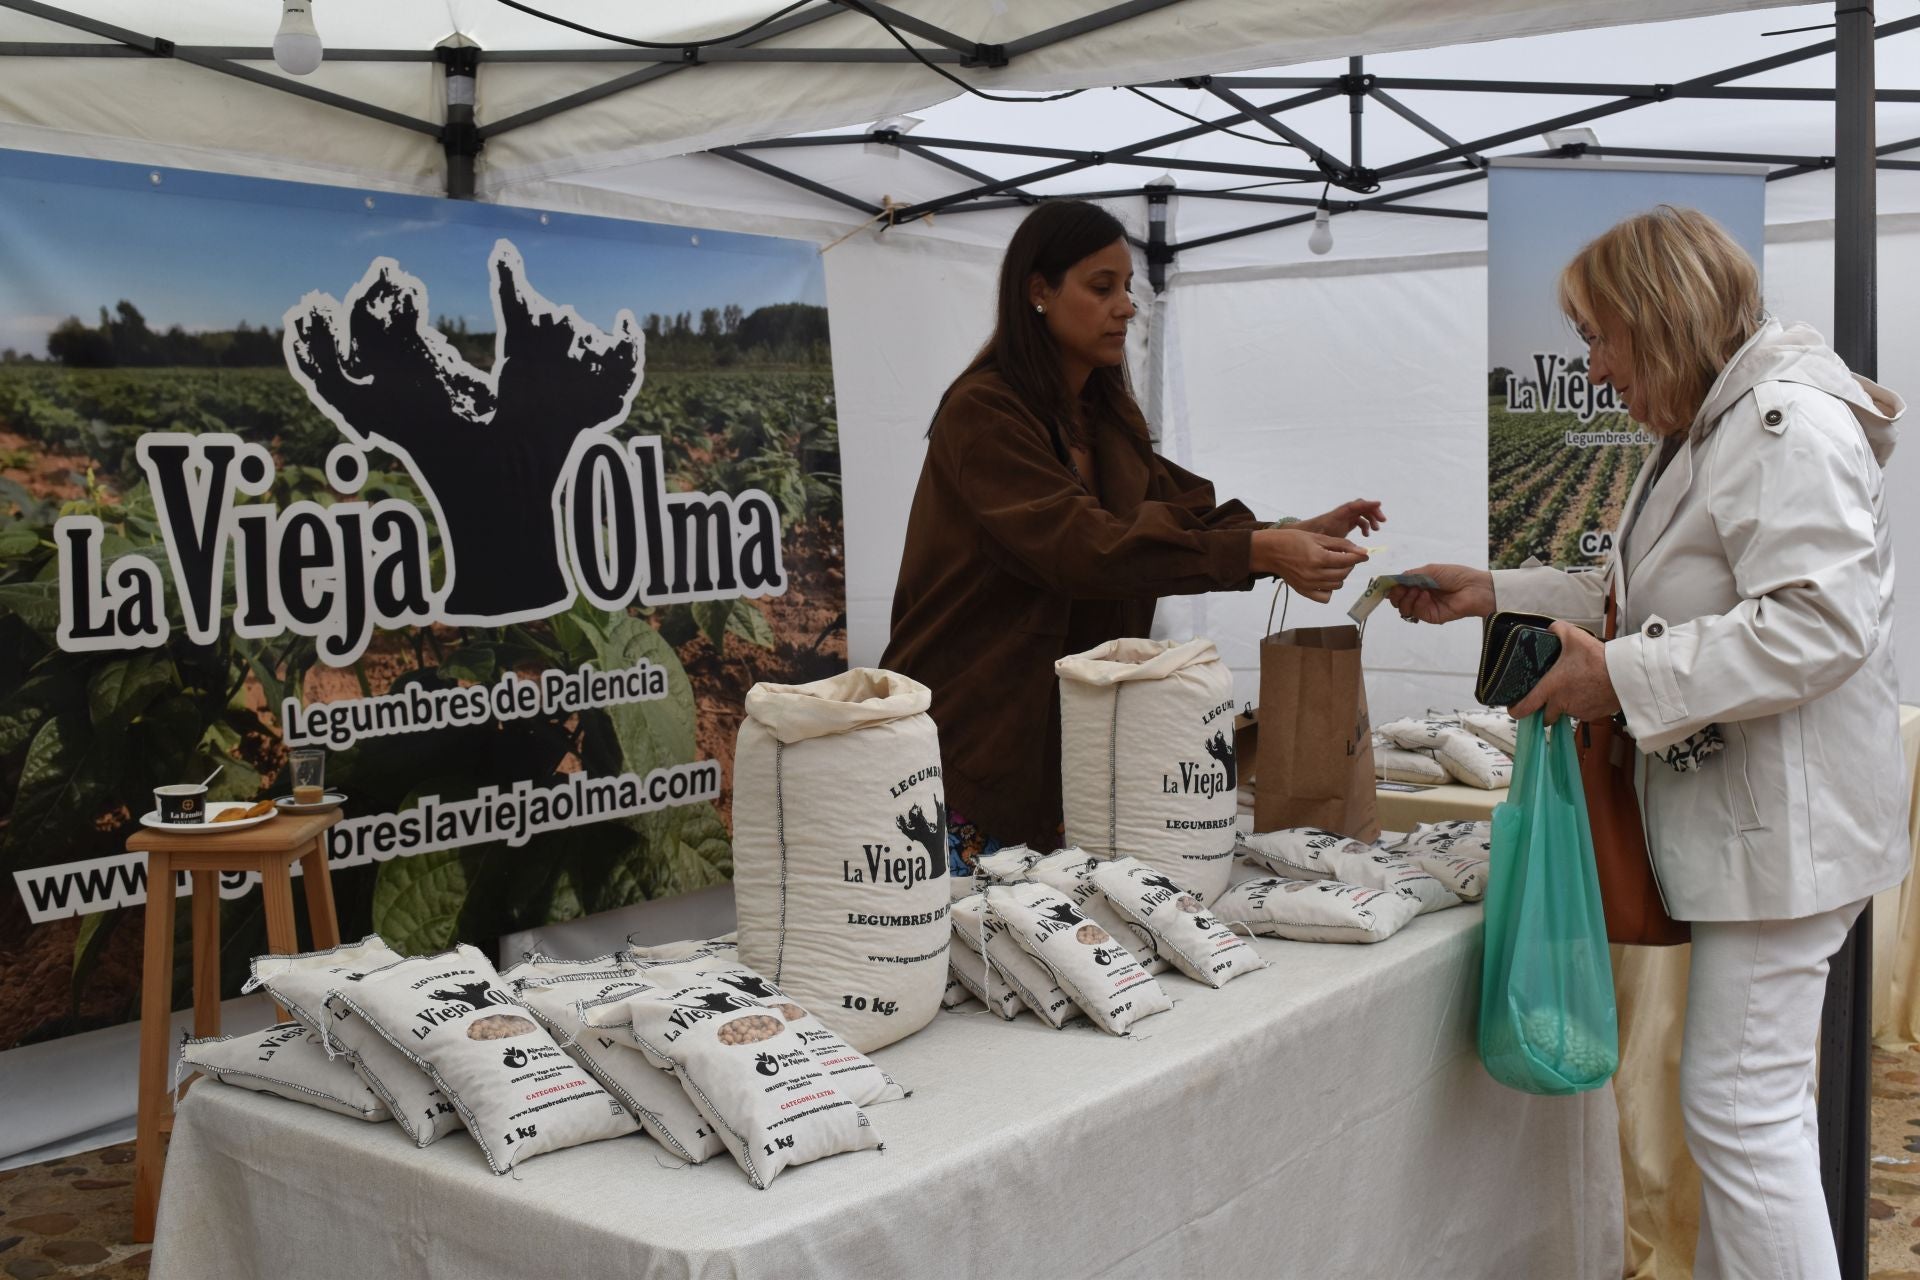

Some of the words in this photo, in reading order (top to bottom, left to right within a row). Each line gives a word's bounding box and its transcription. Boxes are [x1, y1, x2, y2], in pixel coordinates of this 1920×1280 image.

[1509, 378, 1533, 410] La
[1566, 431, 1631, 446] Legumbres
[1635, 431, 1649, 443] de
[66, 527, 158, 639] La
[148, 445, 430, 656] Vieja
[573, 443, 782, 601] Olma
[287, 685, 487, 744] Legumbres
[493, 677, 536, 714] de
[546, 662, 665, 707] Palencia
[1163, 774, 1178, 794] La
[1178, 761, 1224, 800] Vieja
[1166, 818, 1228, 830] LEGUMBRES
[843, 860, 863, 883] La
[863, 844, 927, 890] Vieja
[1073, 897, 1086, 907] La
[1140, 887, 1174, 907] Vieja
[1140, 906, 1154, 917] La
[847, 912, 932, 927] LEGUMBRES
[1035, 931, 1049, 943] La
[1212, 963, 1226, 974] 500
[411, 969, 476, 990] LEGUMBRES
[842, 995, 867, 1011] 10
[872, 998, 899, 1016] kg.
[1051, 999, 1066, 1013] 500
[1110, 1005, 1125, 1019] 500
[334, 1008, 352, 1021] La
[416, 1002, 473, 1027] Vieja
[412, 1025, 431, 1041] La
[664, 1029, 682, 1042] La
[258, 1049, 276, 1062] La
[534, 1071, 563, 1083] PALENCIA
[526, 1084, 566, 1101] CATEGORÍA
[566, 1080, 587, 1089] EXTRA
[786, 1080, 812, 1092] PALENCIA
[816, 1088, 836, 1099] EXTRA
[424, 1108, 436, 1120] 1
[503, 1133, 515, 1146] 1
[516, 1123, 537, 1138] kg
[763, 1143, 775, 1157] 1
[774, 1133, 795, 1150] kg
